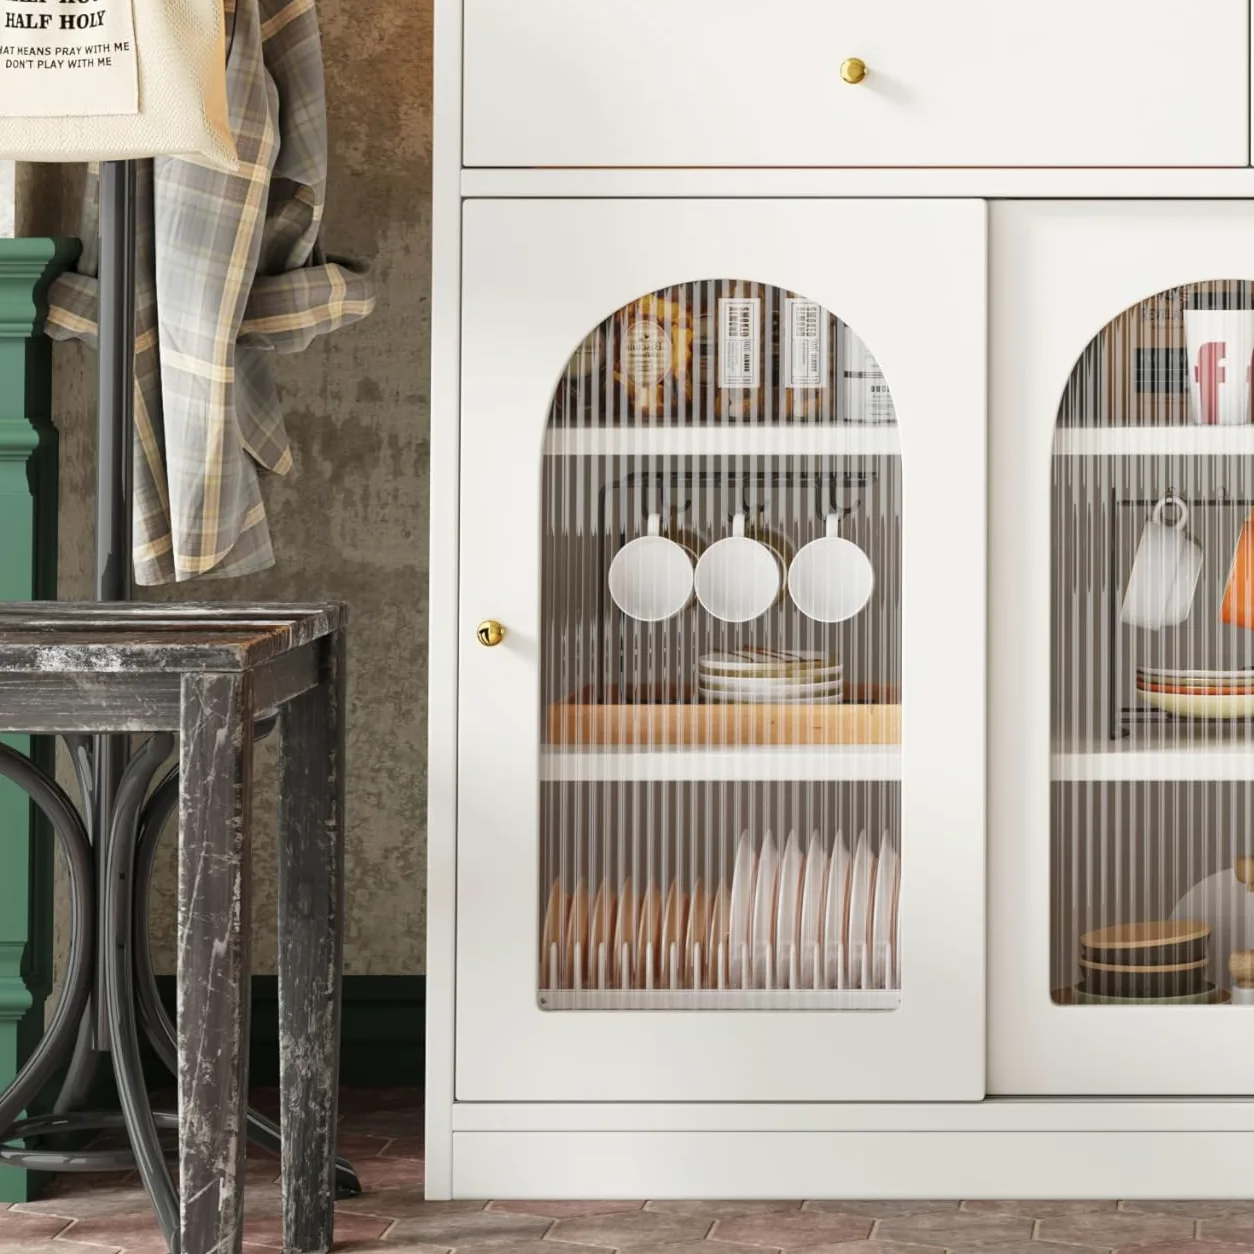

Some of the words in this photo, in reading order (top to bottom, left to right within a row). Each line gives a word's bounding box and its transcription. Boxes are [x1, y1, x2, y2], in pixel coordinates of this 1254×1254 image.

[5, 11, 53, 29] HALF
[59, 10, 106, 30] HOLY
[17, 46, 52, 56] MEANS
[55, 46, 82, 56] PRAY
[85, 43, 110, 54] WITH
[114, 42, 130, 52] ME
[5, 59, 34, 69] DON'T
[37, 59, 64, 69] PLAY
[68, 57, 94, 69] WITH
[97, 57, 112, 66] ME
